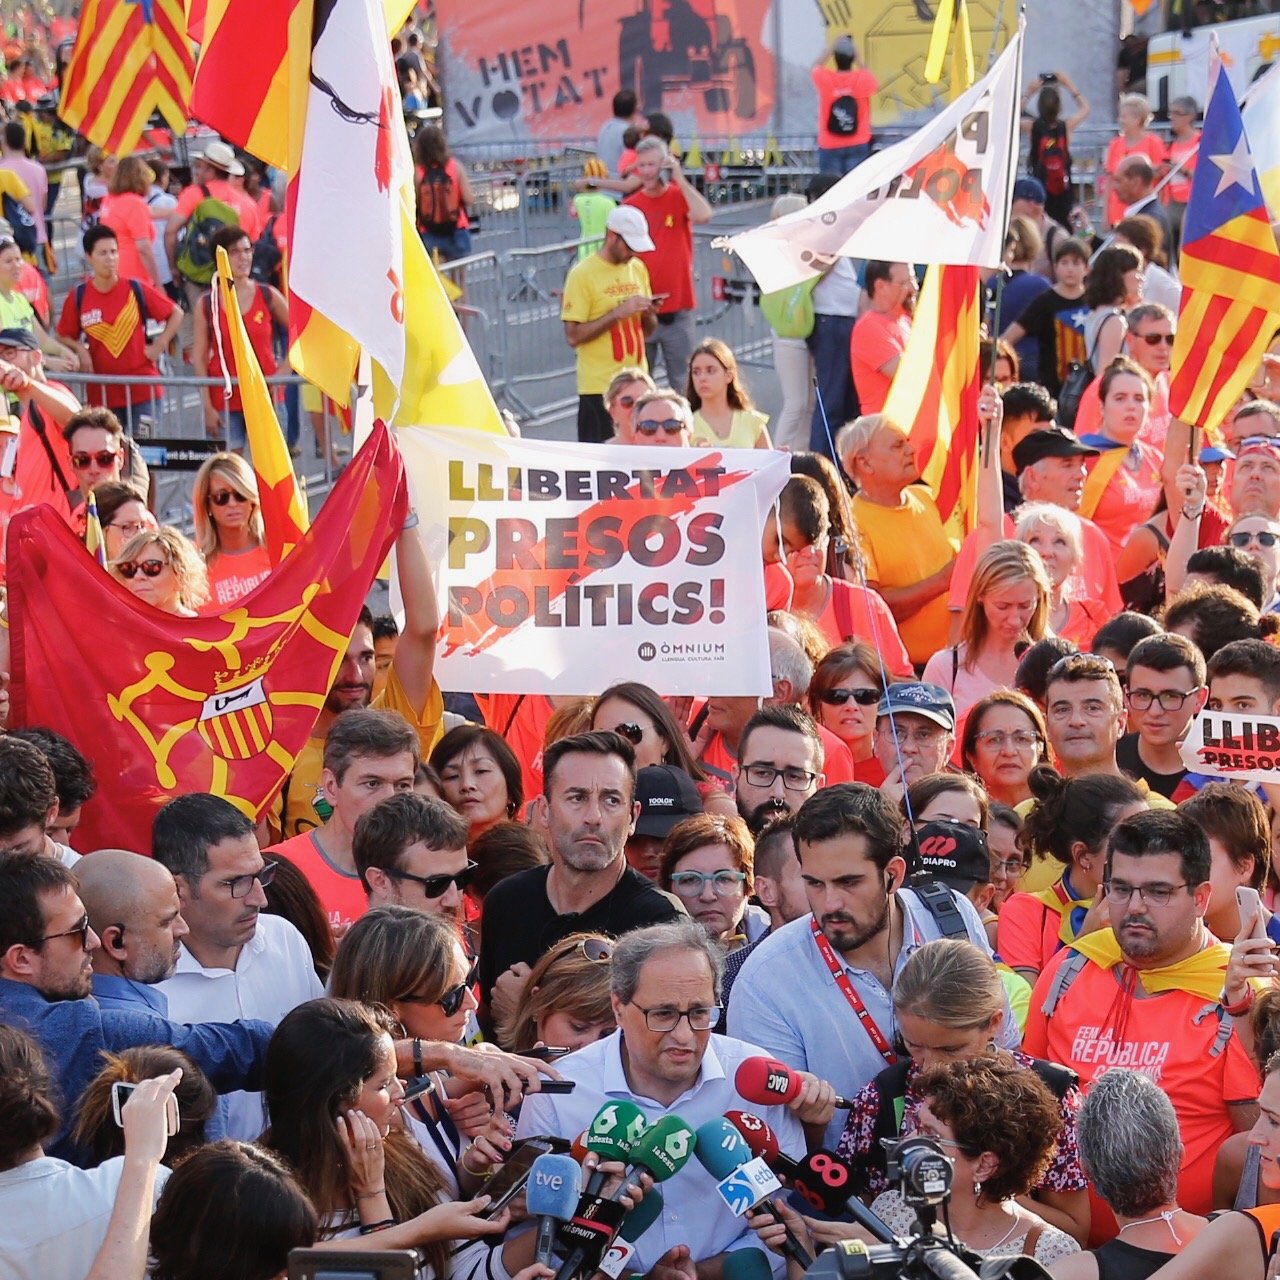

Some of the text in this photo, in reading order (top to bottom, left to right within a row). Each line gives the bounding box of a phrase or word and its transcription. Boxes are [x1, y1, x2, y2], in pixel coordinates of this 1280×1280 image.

[479, 40, 572, 89] HEM
[455, 67, 608, 127] VOTAT
[448, 466, 727, 502] LLIBERTAT
[448, 513, 727, 573] PRESOS
[447, 573, 726, 628] POLÍTICS!
[661, 642, 725, 654] ÒMNIUM
[913, 857, 957, 868] DIAPRO
[1076, 1025, 1115, 1041] FEM LA
[1072, 1037, 1172, 1067] REPÚBLICA
[767, 1074, 788, 1093] RAC
[588, 1134, 615, 1145] laSexta
[651, 1145, 676, 1172] laSexta
[535, 1169, 563, 1190] tve
[754, 1166, 774, 1186] etb
